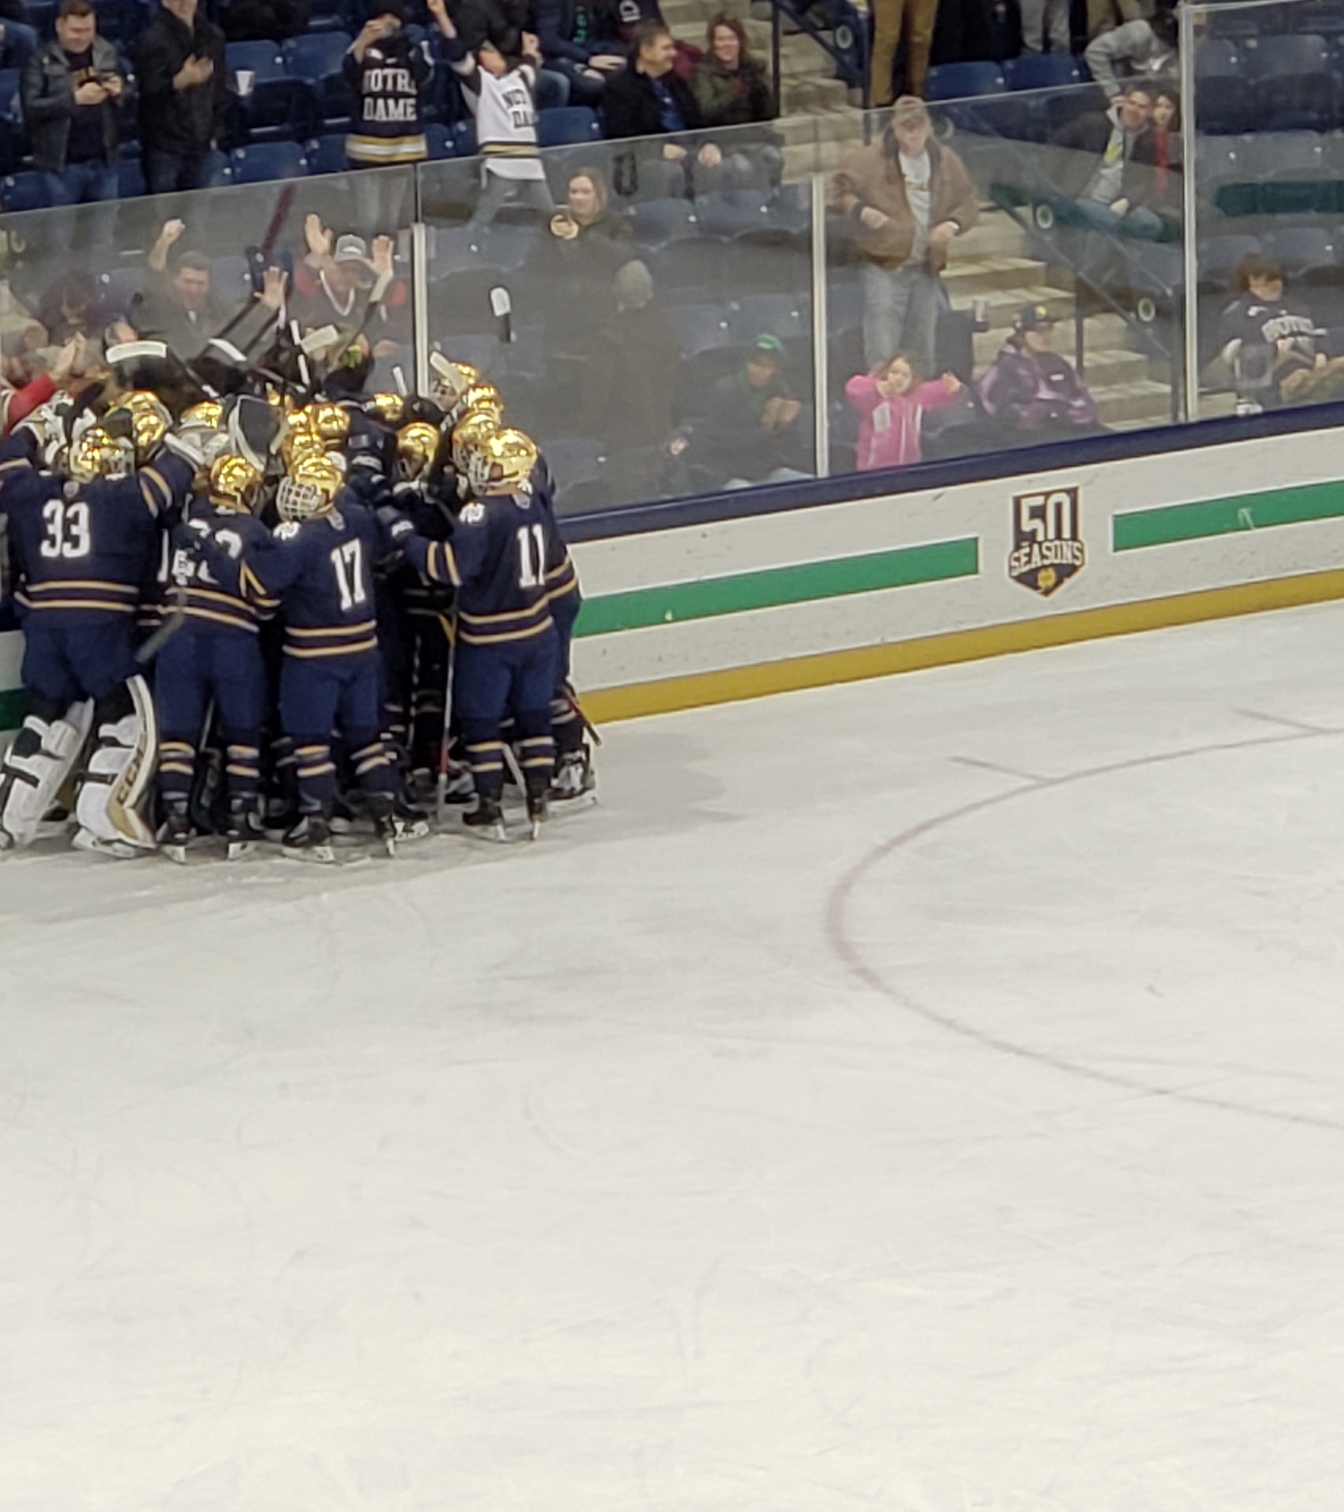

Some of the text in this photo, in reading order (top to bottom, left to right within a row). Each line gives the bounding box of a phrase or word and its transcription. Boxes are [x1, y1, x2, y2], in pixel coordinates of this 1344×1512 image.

[362, 96, 418, 122] DAME
[40, 498, 91, 558] 33
[1020, 492, 1072, 542] 50
[330, 538, 367, 612] 17
[516, 523, 547, 588] 11
[1009, 538, 1084, 577] SEASONS
